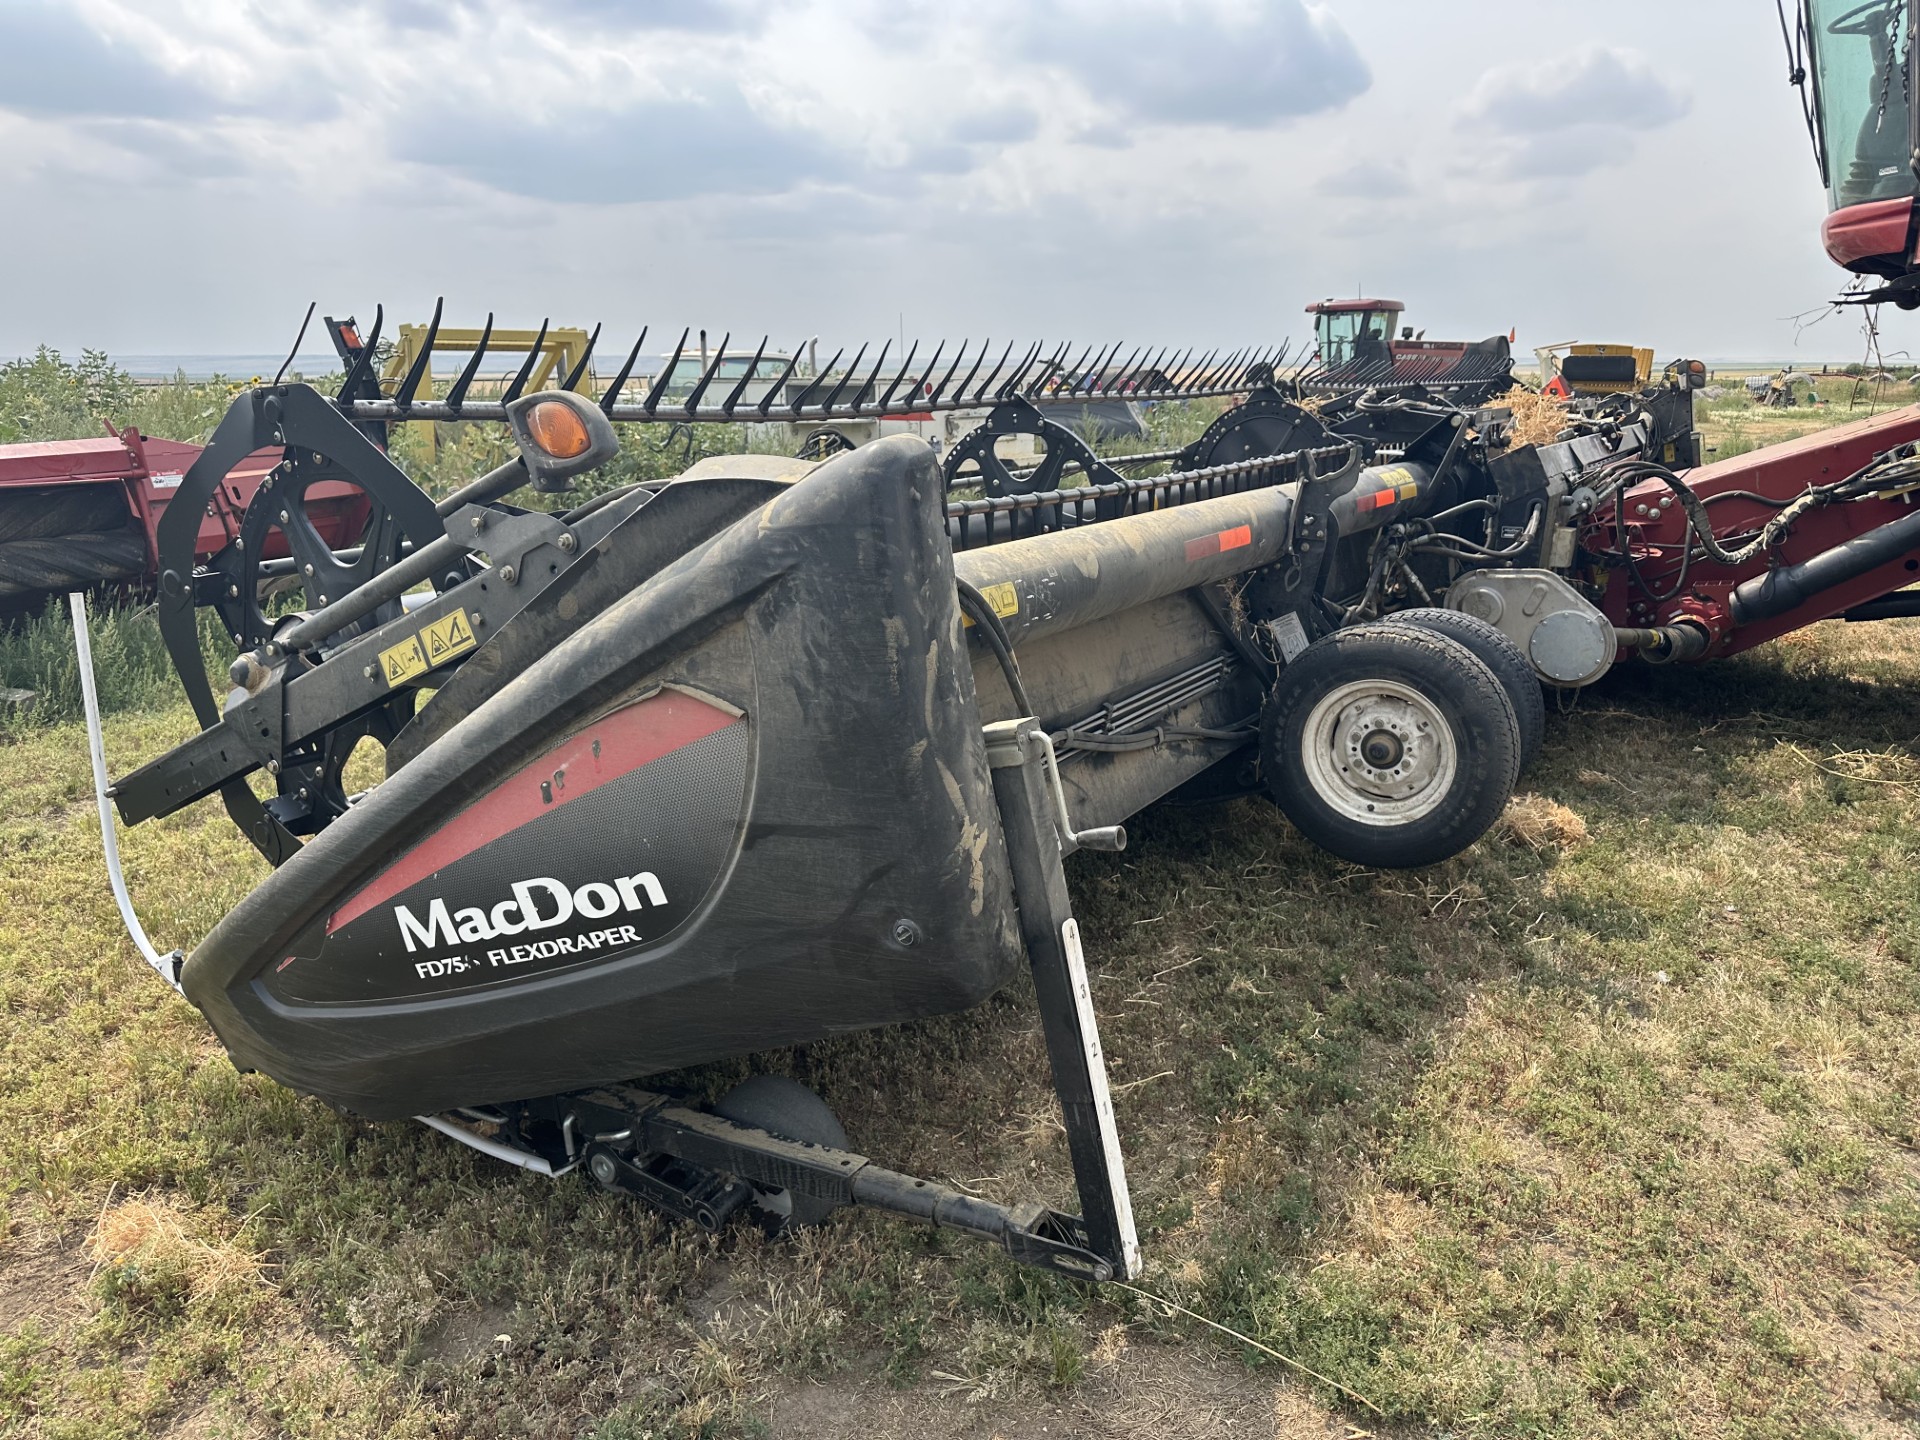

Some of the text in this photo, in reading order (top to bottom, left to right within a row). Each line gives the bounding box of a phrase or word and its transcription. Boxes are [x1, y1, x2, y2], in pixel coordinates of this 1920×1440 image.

[394, 871, 669, 953] MacDon
[1069, 925, 1075, 940] 4
[487, 924, 643, 967] FLEXDRAPER
[1080, 983, 1087, 999] 3
[1091, 1042, 1098, 1058] 2
